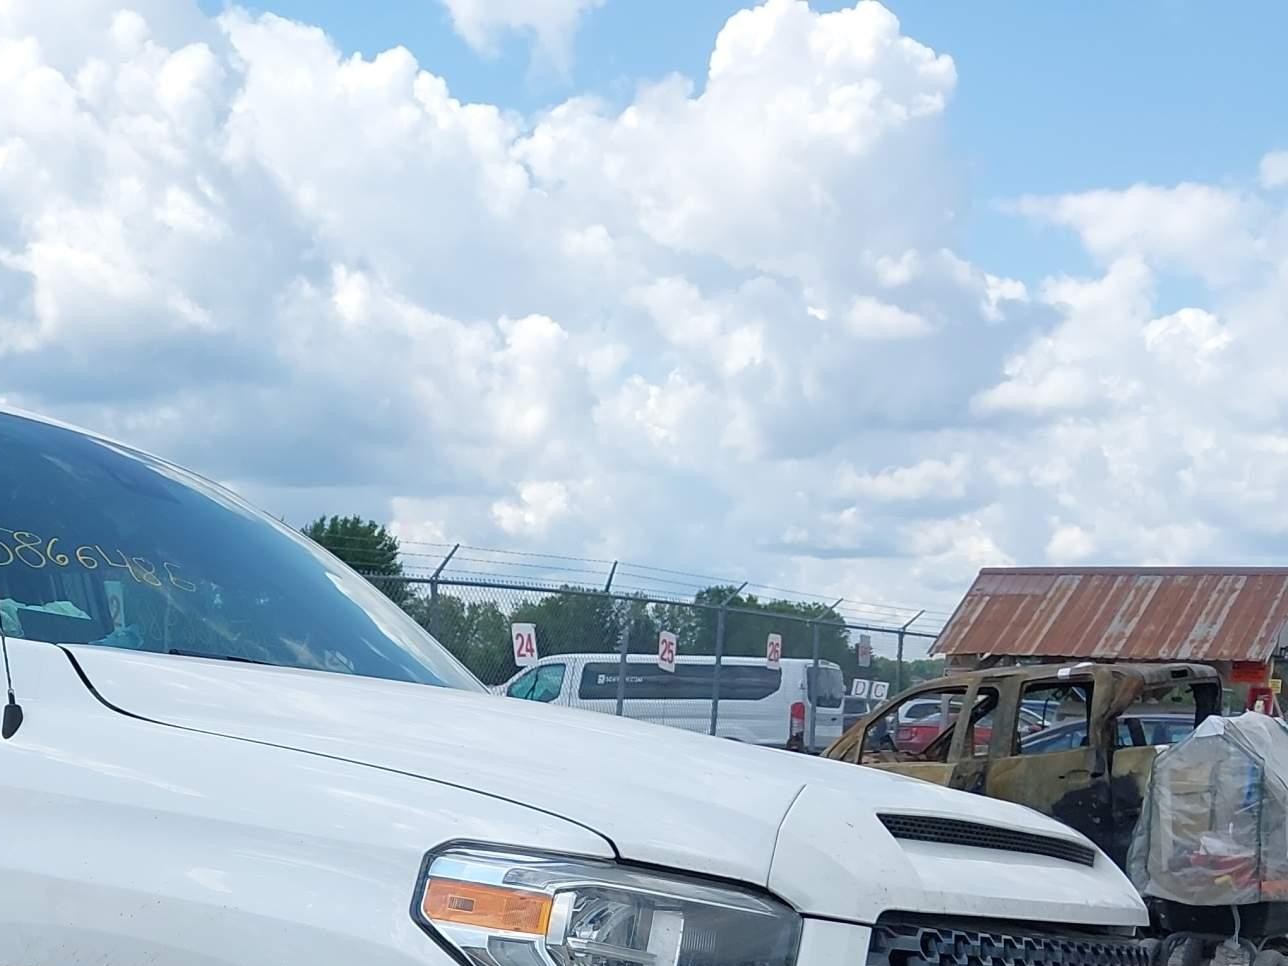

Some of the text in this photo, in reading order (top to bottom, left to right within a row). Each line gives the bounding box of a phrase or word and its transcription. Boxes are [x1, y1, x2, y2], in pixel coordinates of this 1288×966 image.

[515, 633, 535, 657] 24
[660, 639, 674, 663] 25
[768, 641, 780, 662] 26
[855, 681, 866, 695] D
[874, 684, 885, 698] C
